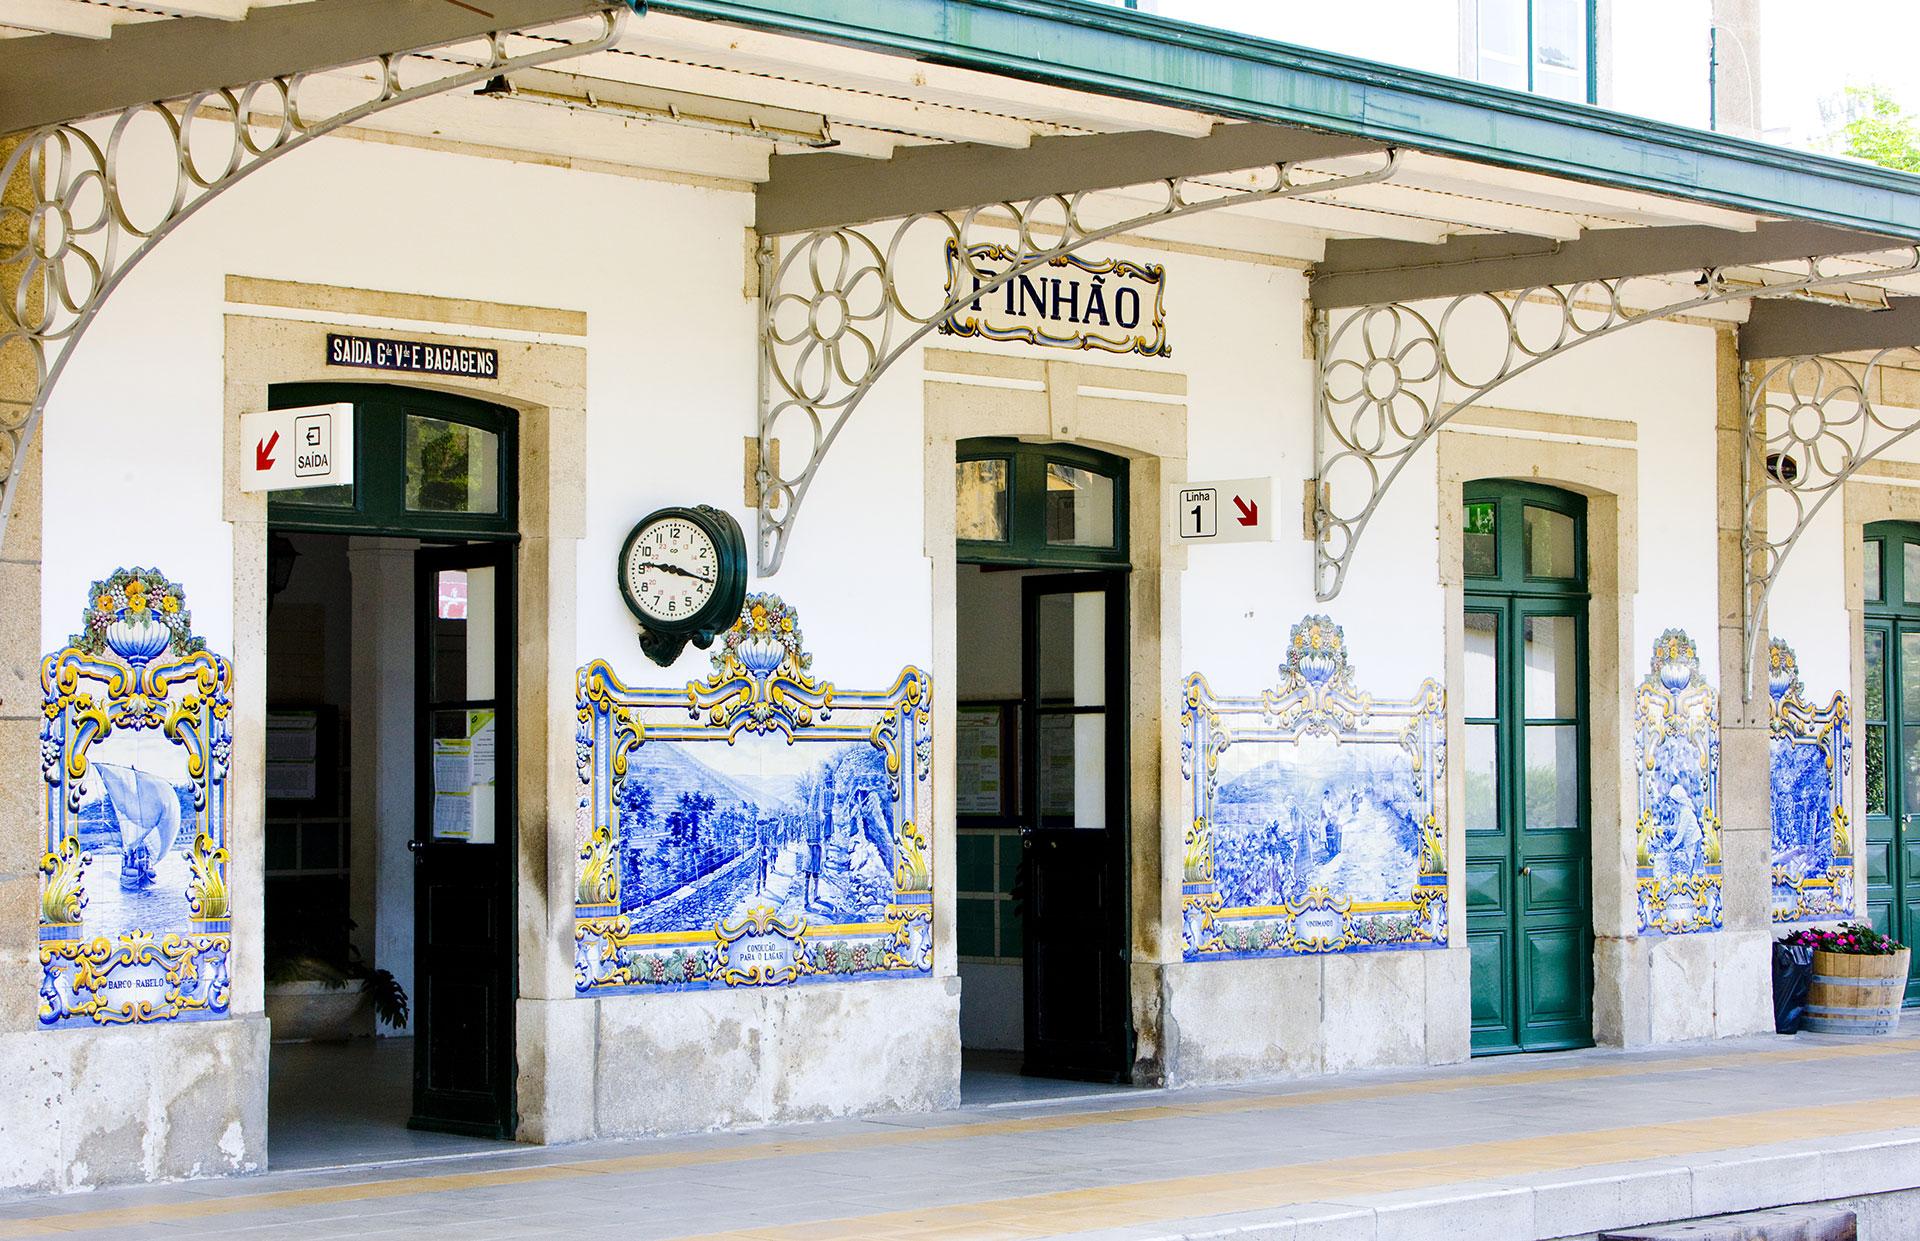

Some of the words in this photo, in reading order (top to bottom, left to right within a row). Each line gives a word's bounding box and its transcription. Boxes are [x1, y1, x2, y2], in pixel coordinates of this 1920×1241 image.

[970, 269, 1140, 329] PINHÃO
[333, 337, 372, 364] SAÍDA
[412, 345, 420, 369] E
[425, 347, 494, 374] BAGAGENS
[298, 451, 328, 469] SAÍDA
[1186, 492, 1210, 502] Linha
[1191, 505, 1201, 533] 1
[670, 528, 680, 538] 12
[642, 546, 651, 557] 10
[700, 548, 707, 558] 2
[703, 566, 709, 576] 3
[641, 582, 648, 592] 8
[697, 584, 704, 594] 4
[654, 596, 660, 605] 7
[685, 597, 691, 606] 5
[669, 601, 675, 611] 6
[740, 953, 755, 961] PARA
[109, 980, 132, 989] BARCO
